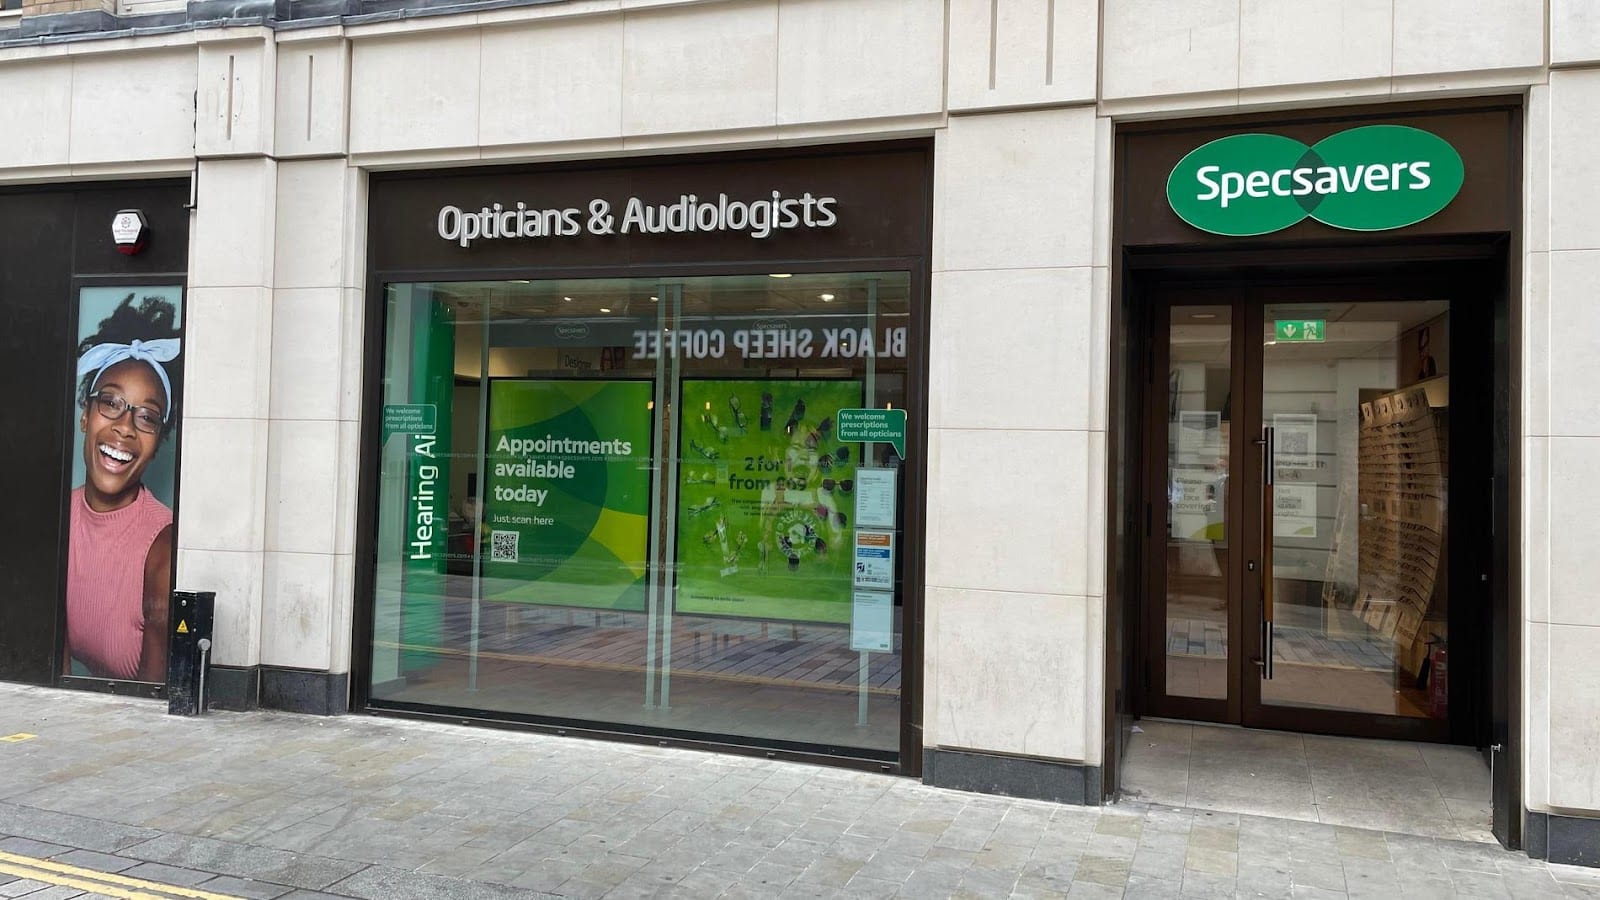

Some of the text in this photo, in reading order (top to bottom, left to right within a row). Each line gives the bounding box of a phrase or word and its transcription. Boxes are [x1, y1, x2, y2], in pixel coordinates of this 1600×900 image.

[1195, 160, 1432, 208] Specsavers
[437, 190, 838, 248] Opticians & Audiologists
[385, 415, 423, 423] prescriptions
[841, 412, 886, 421] We welcome
[385, 422, 400, 430] from
[407, 422, 434, 431] opticians
[841, 421, 889, 430] prescriptions
[841, 429, 859, 438] from
[869, 429, 903, 439] opticians
[496, 434, 632, 457] Appointments
[494, 459, 576, 479] available
[745, 457, 756, 472] 2
[757, 456, 783, 472] for
[728, 473, 771, 490] from
[410, 434, 438, 560] Hearing Ai
[494, 485, 549, 507] today
[492, 514, 555, 526] Just scan here
